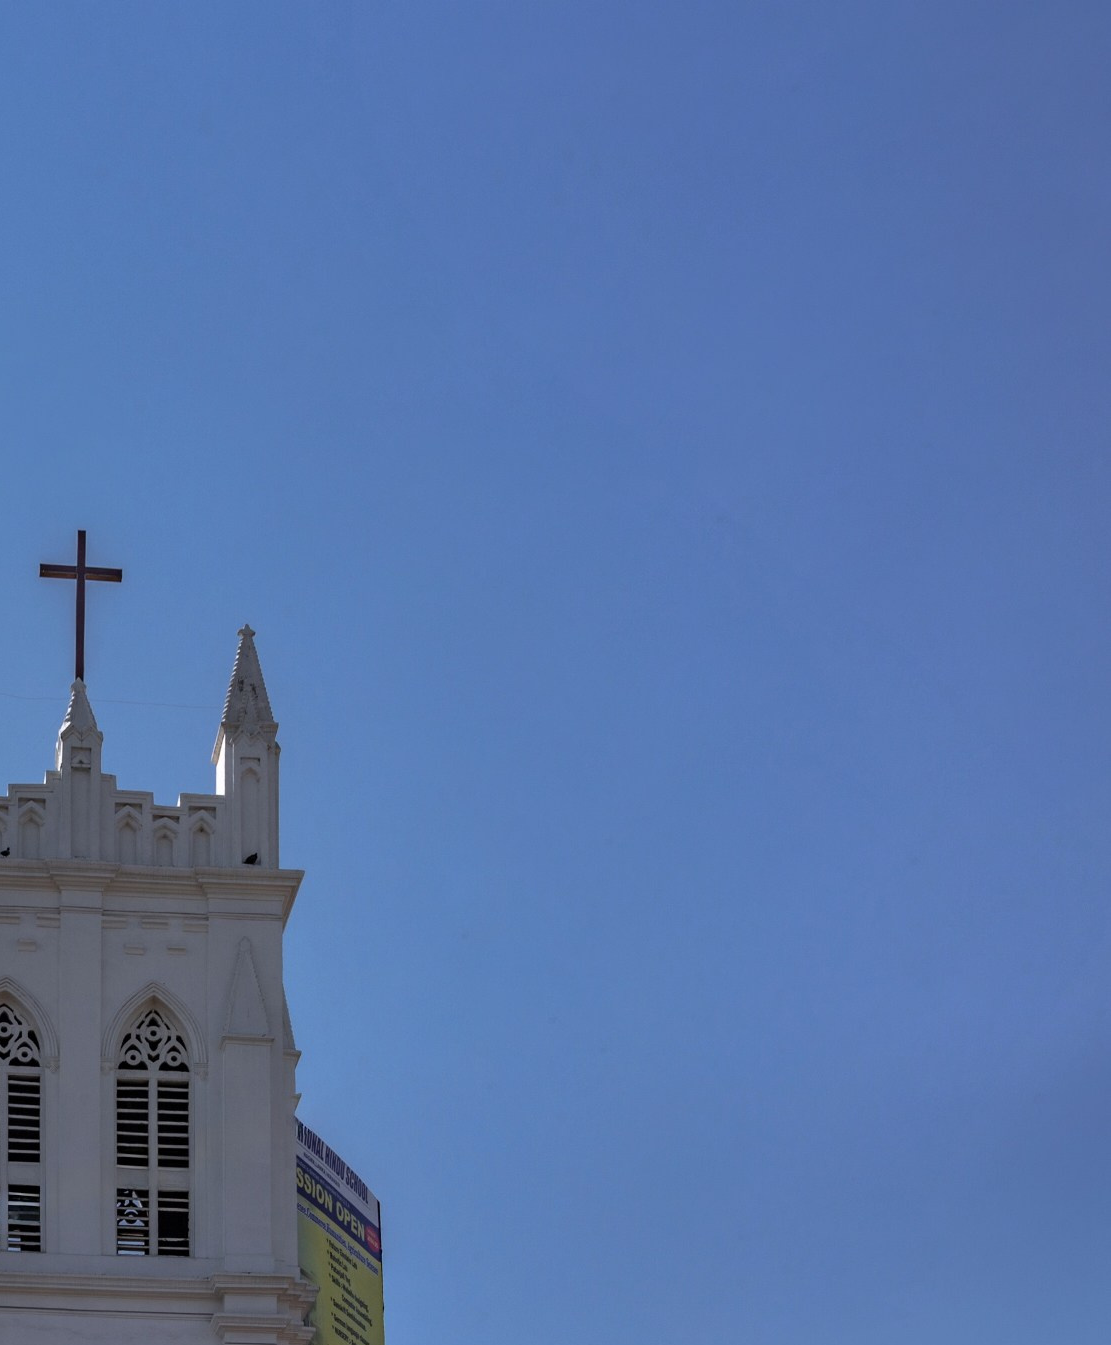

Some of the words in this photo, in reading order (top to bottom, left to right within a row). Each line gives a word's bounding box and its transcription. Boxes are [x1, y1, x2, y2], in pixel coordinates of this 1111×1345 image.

[325, 1145, 346, 1180] HINDU
[346, 1166, 369, 1204] SCHOOL
[336, 1202, 366, 1242] OPEN
